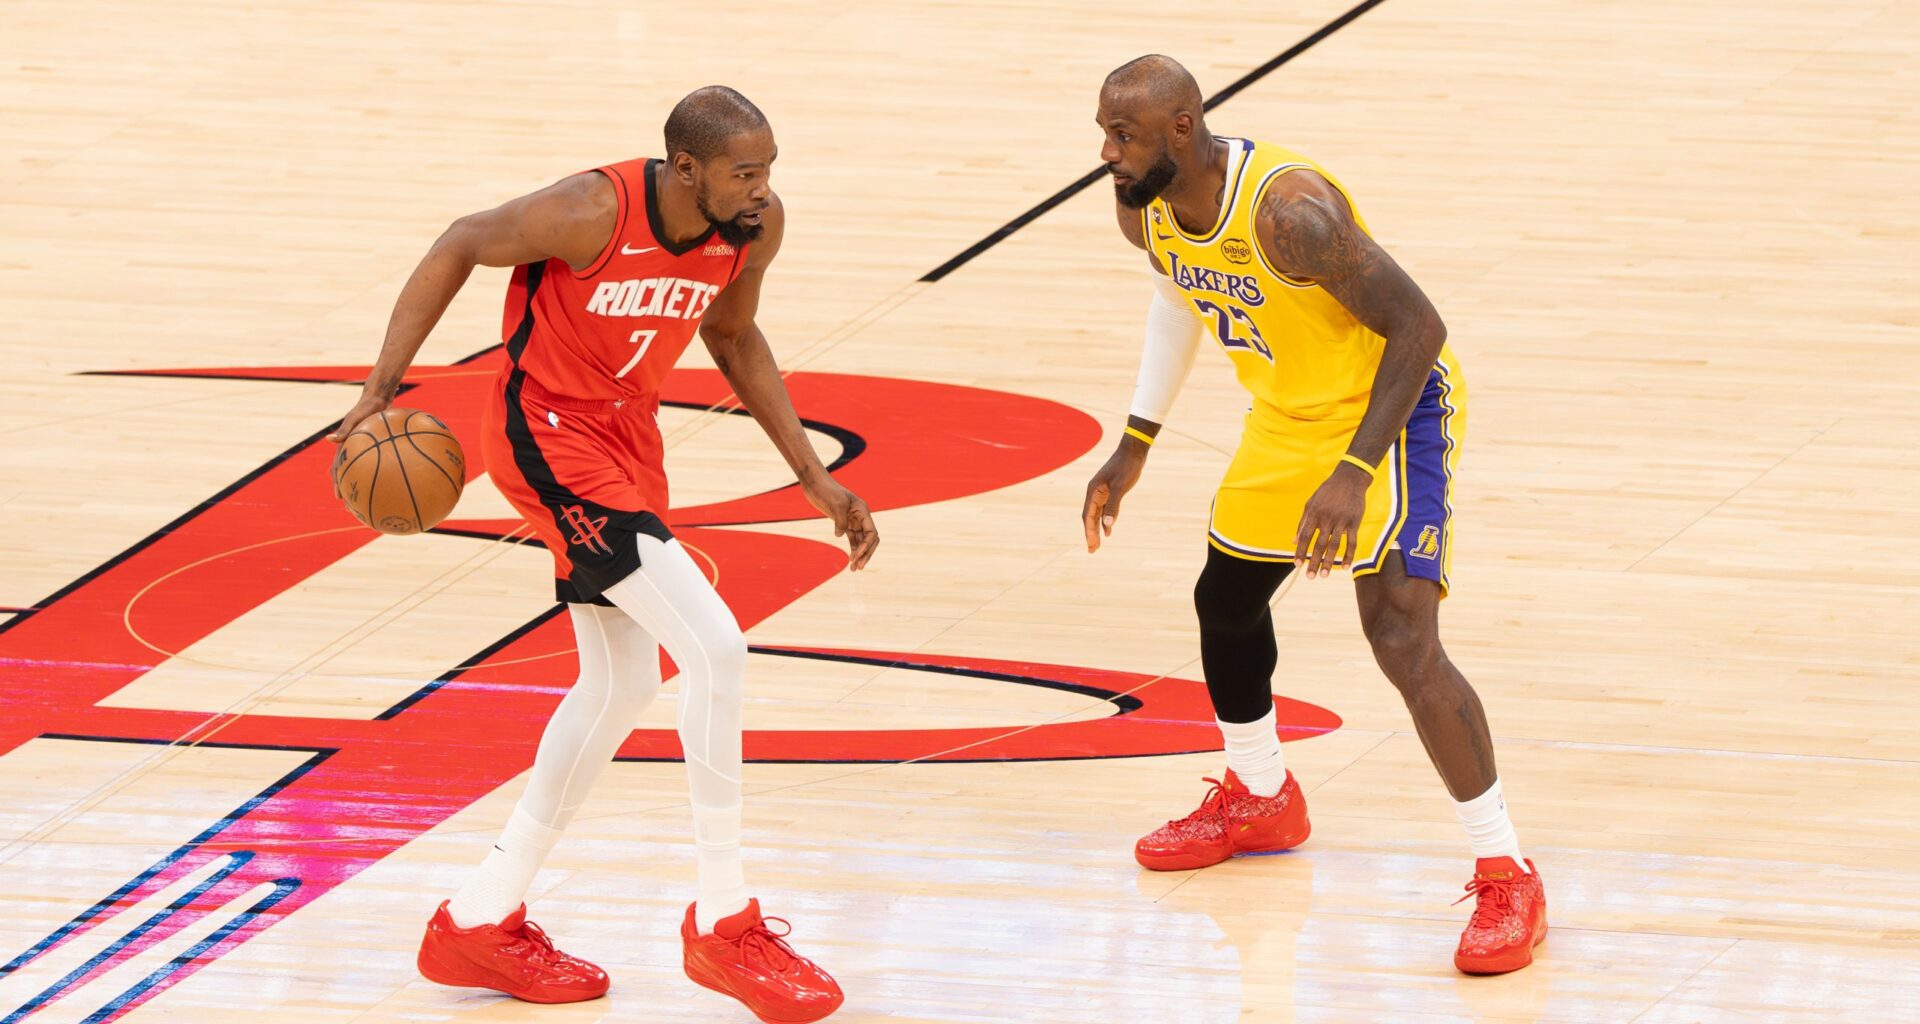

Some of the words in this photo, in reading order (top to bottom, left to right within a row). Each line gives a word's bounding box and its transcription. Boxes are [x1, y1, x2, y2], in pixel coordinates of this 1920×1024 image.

[1223, 245, 1250, 258] bibigo
[585, 277, 720, 320] ROCKETS
[1166, 250, 1267, 308] LAKERS
[615, 329, 658, 378] 7
[1192, 298, 1276, 367] 23
